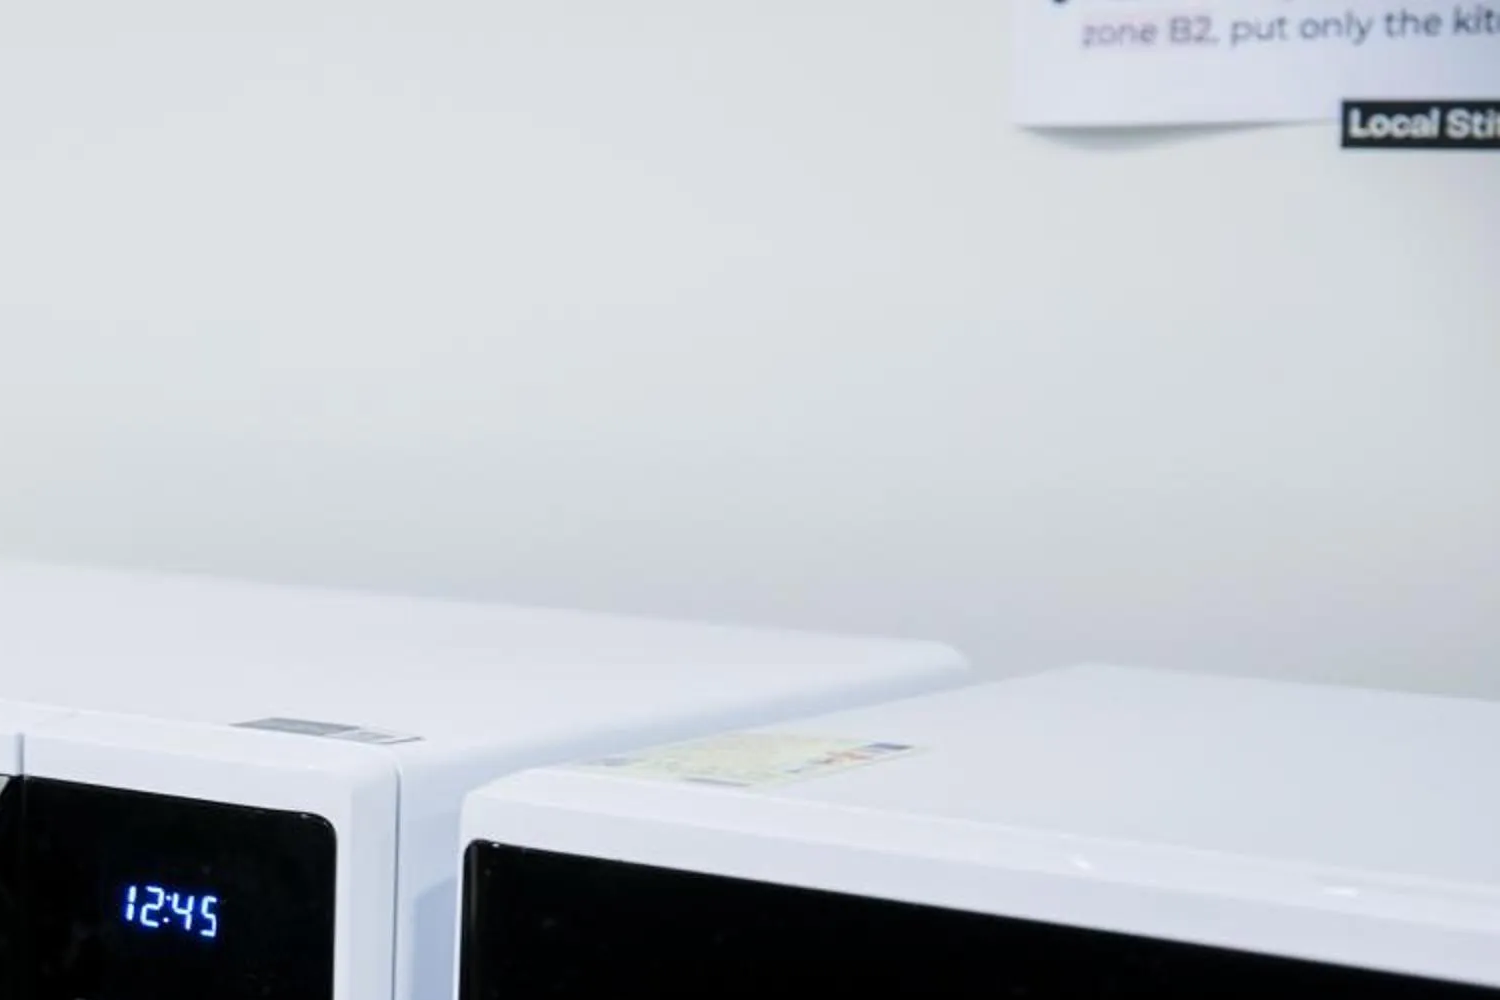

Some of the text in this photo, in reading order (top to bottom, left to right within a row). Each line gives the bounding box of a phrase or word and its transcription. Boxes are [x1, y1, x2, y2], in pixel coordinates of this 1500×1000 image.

[1082, 23, 1159, 48] zone
[1229, 15, 1288, 47] put
[1299, 10, 1375, 46] only
[1385, 9, 1443, 38] the
[1453, 6, 1500, 34] kit
[1349, 107, 1441, 139] Local
[125, 885, 218, 938] 12:45
